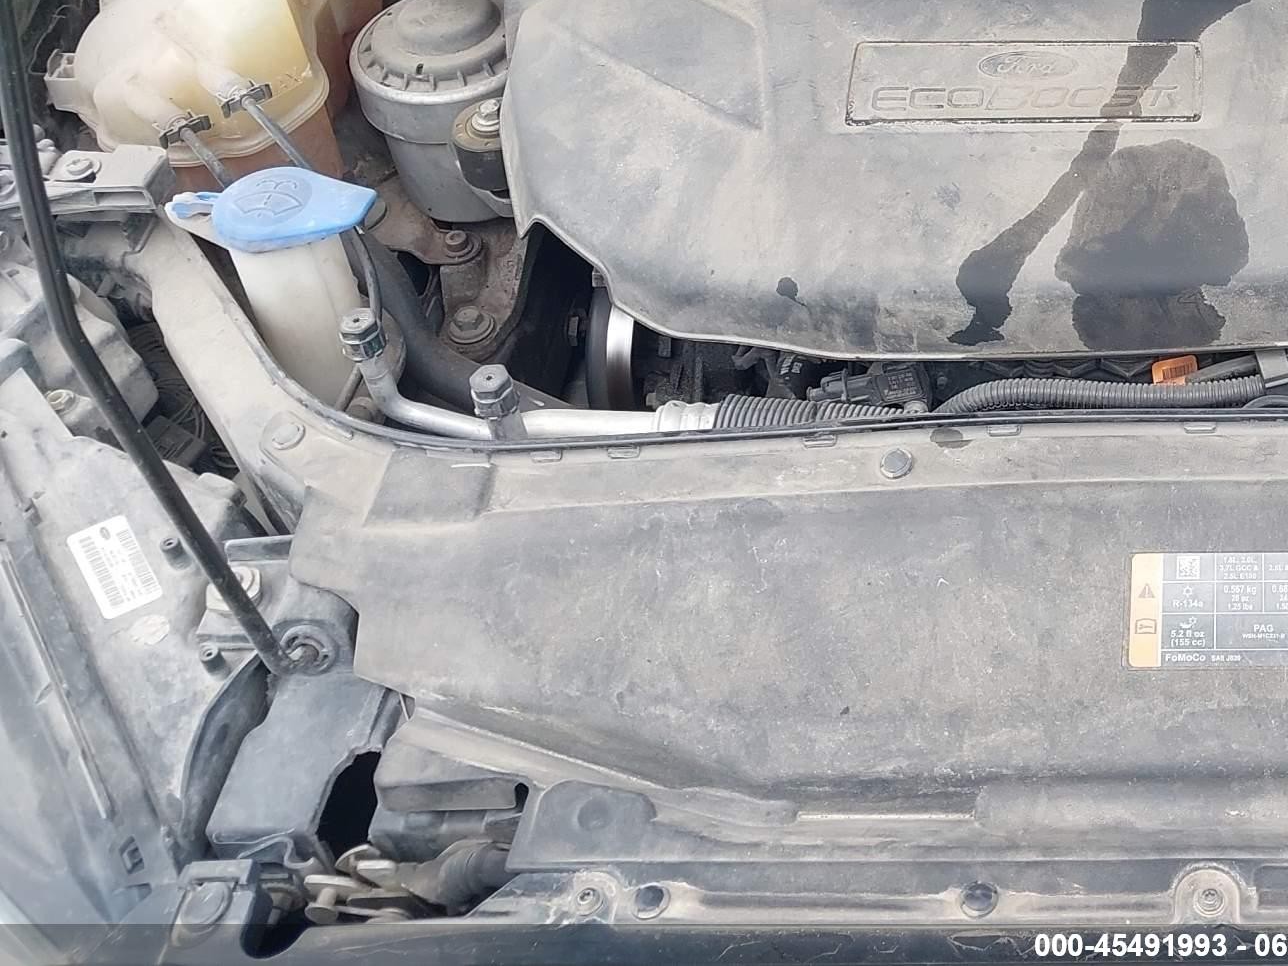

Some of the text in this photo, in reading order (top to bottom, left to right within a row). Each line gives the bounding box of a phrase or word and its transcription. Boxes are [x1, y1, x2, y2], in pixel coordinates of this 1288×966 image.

[1246, 585, 1257, 595] kg
[1172, 599, 1204, 608] R-134a
[1253, 624, 1274, 633] PAG
[1170, 630, 1184, 638] 5.2
[1186, 630, 1192, 638] fl
[1170, 638, 1206, 648] (155 cc)
[1165, 653, 1206, 662] FoMoCo
